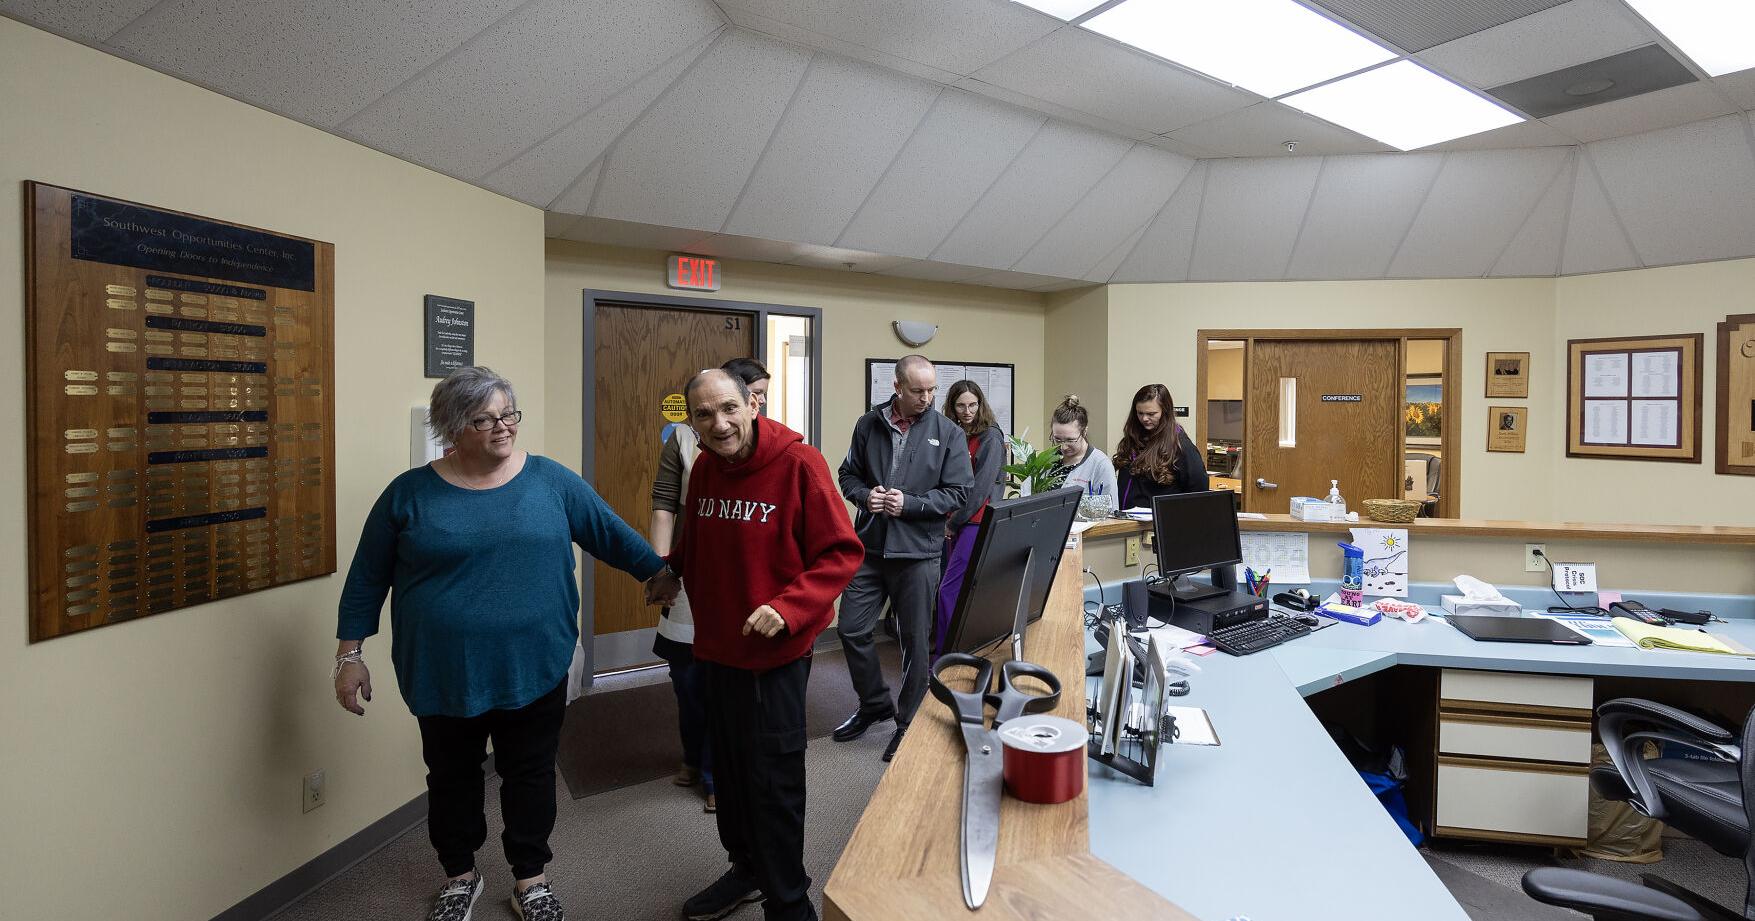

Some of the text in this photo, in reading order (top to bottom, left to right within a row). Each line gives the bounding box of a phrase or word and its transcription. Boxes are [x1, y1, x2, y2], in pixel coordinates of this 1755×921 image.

[103, 218, 166, 236] Southwest
[172, 229, 242, 251] Opportunities
[282, 251, 297, 261] Inc.
[137, 244, 274, 272] Opening Doors to Independence
[677, 257, 716, 288] EXIT
[725, 317, 740, 330] S1
[698, 498, 776, 522] LD NAVY
